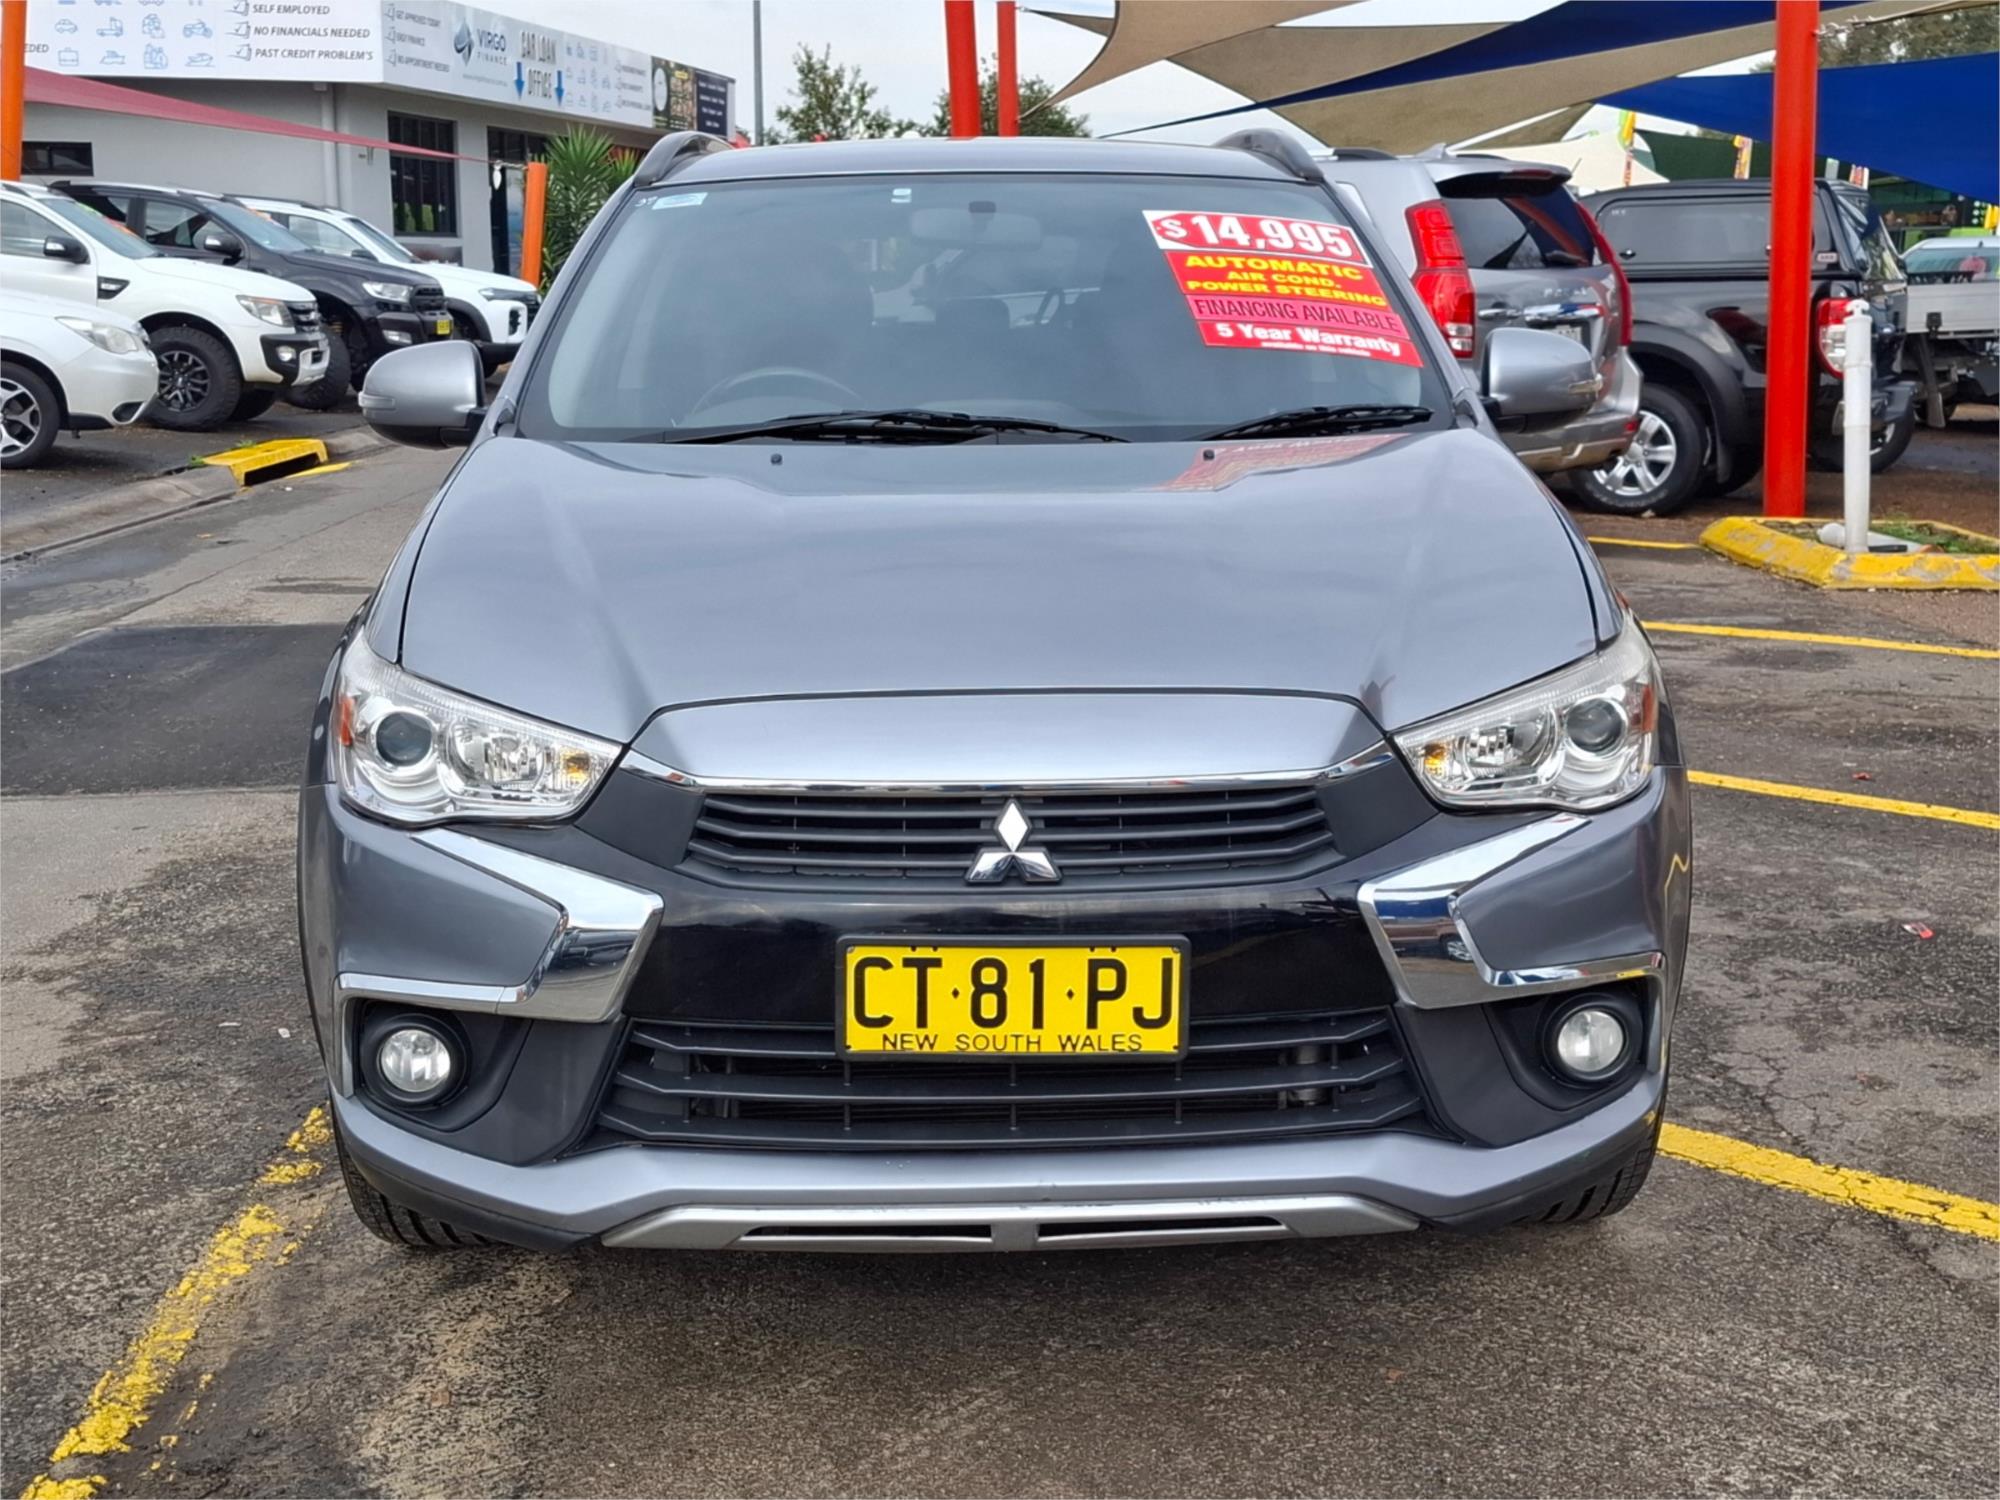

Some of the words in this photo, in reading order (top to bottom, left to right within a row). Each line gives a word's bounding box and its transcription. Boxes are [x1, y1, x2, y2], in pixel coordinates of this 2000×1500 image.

[252, 4, 276, 13] SELF
[277, 5, 330, 15] EMPLOYED
[254, 26, 269, 35] NO
[271, 26, 328, 37] FINANCIALS
[330, 28, 370, 38] NEEDED
[476, 28, 506, 52] VIRGO
[255, 48, 279, 58] PAST
[281, 48, 316, 59] CREDIT
[318, 50, 373, 60] PROBLEM'S
[521, 30, 537, 61] CAR
[538, 34, 557, 65] LOAN
[528, 67, 552, 99] OFFICE
[1186, 255, 1363, 280] AUTOMATIC
[1227, 271, 1267, 282] AIR
[1271, 273, 1342, 288] COND.
[1186, 280, 1271, 294] POWER
[1275, 285, 1387, 307] STEERING
[1194, 300, 1299, 321] FINANCING
[1303, 305, 1401, 332] AVAILABLE
[1216, 323, 1233, 338] 5
[1237, 323, 1292, 341] Year
[1296, 326, 1400, 356] Warranty
[882, 1033, 939, 1050] NEW
[955, 1033, 1042, 1051] SOUTH
[1058, 1033, 1143, 1052] WALES
